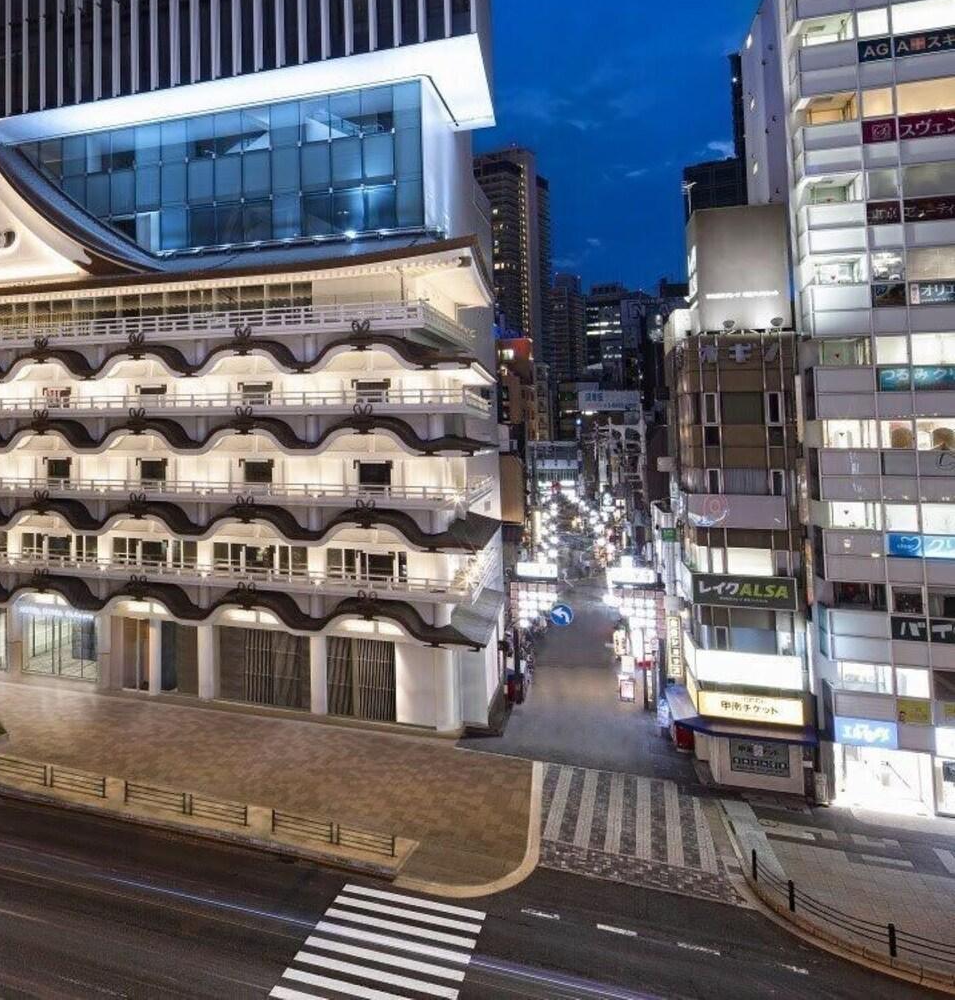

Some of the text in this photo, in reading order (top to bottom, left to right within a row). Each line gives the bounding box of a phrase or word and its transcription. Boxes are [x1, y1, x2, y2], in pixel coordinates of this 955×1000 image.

[863, 39, 909, 57] AGA
[698, 580, 788, 599] レイクALSA
[720, 700, 778, 715] 甲南チケット
